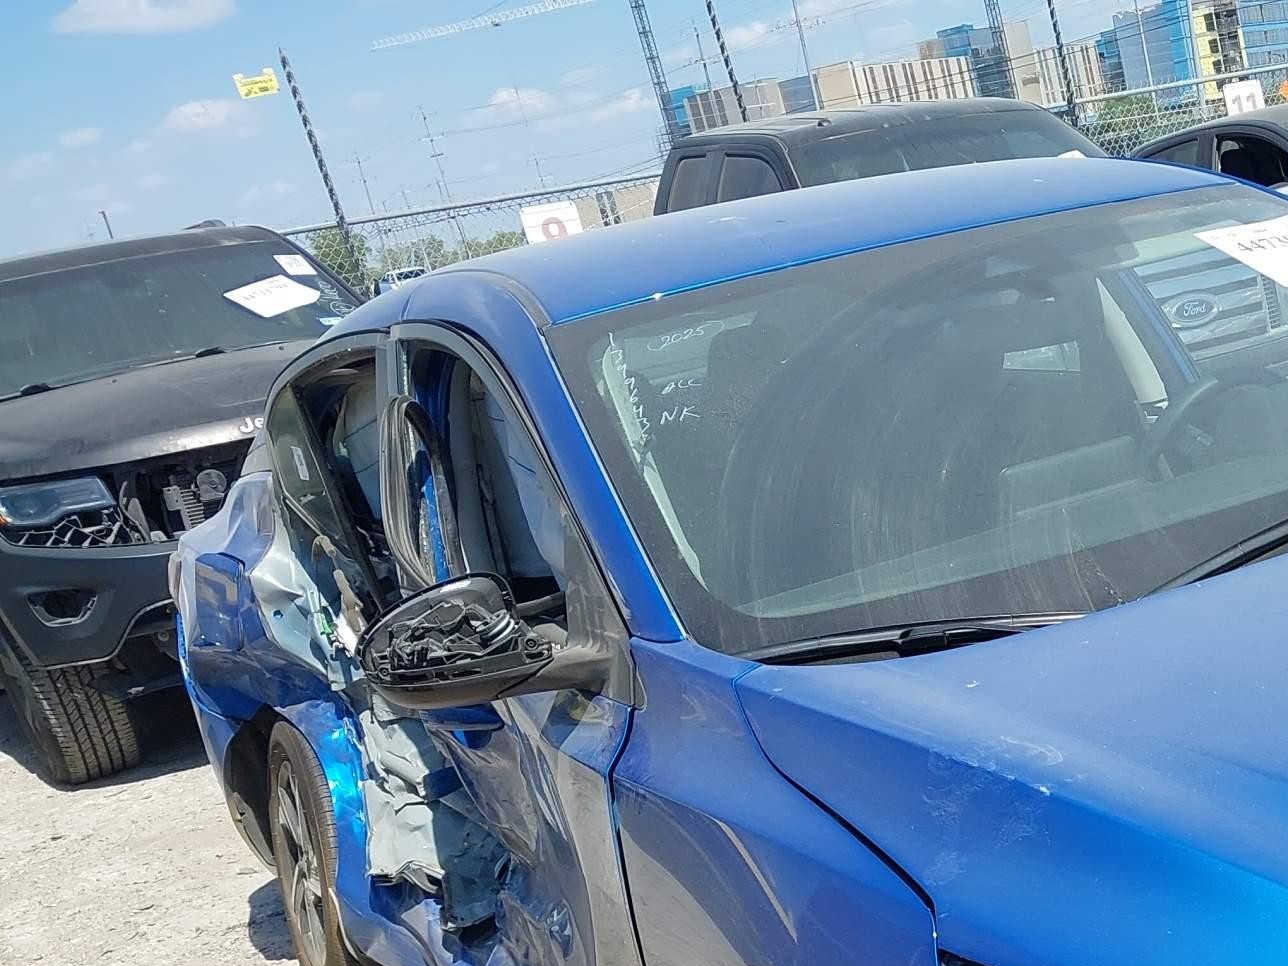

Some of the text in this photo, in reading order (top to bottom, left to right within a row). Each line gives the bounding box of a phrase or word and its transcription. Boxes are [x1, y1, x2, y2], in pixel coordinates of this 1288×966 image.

[1183, 302, 1207, 317] Ford
[647, 323, 712, 351] 2025
[660, 405, 700, 424] NK
[240, 417, 264, 433] Je
